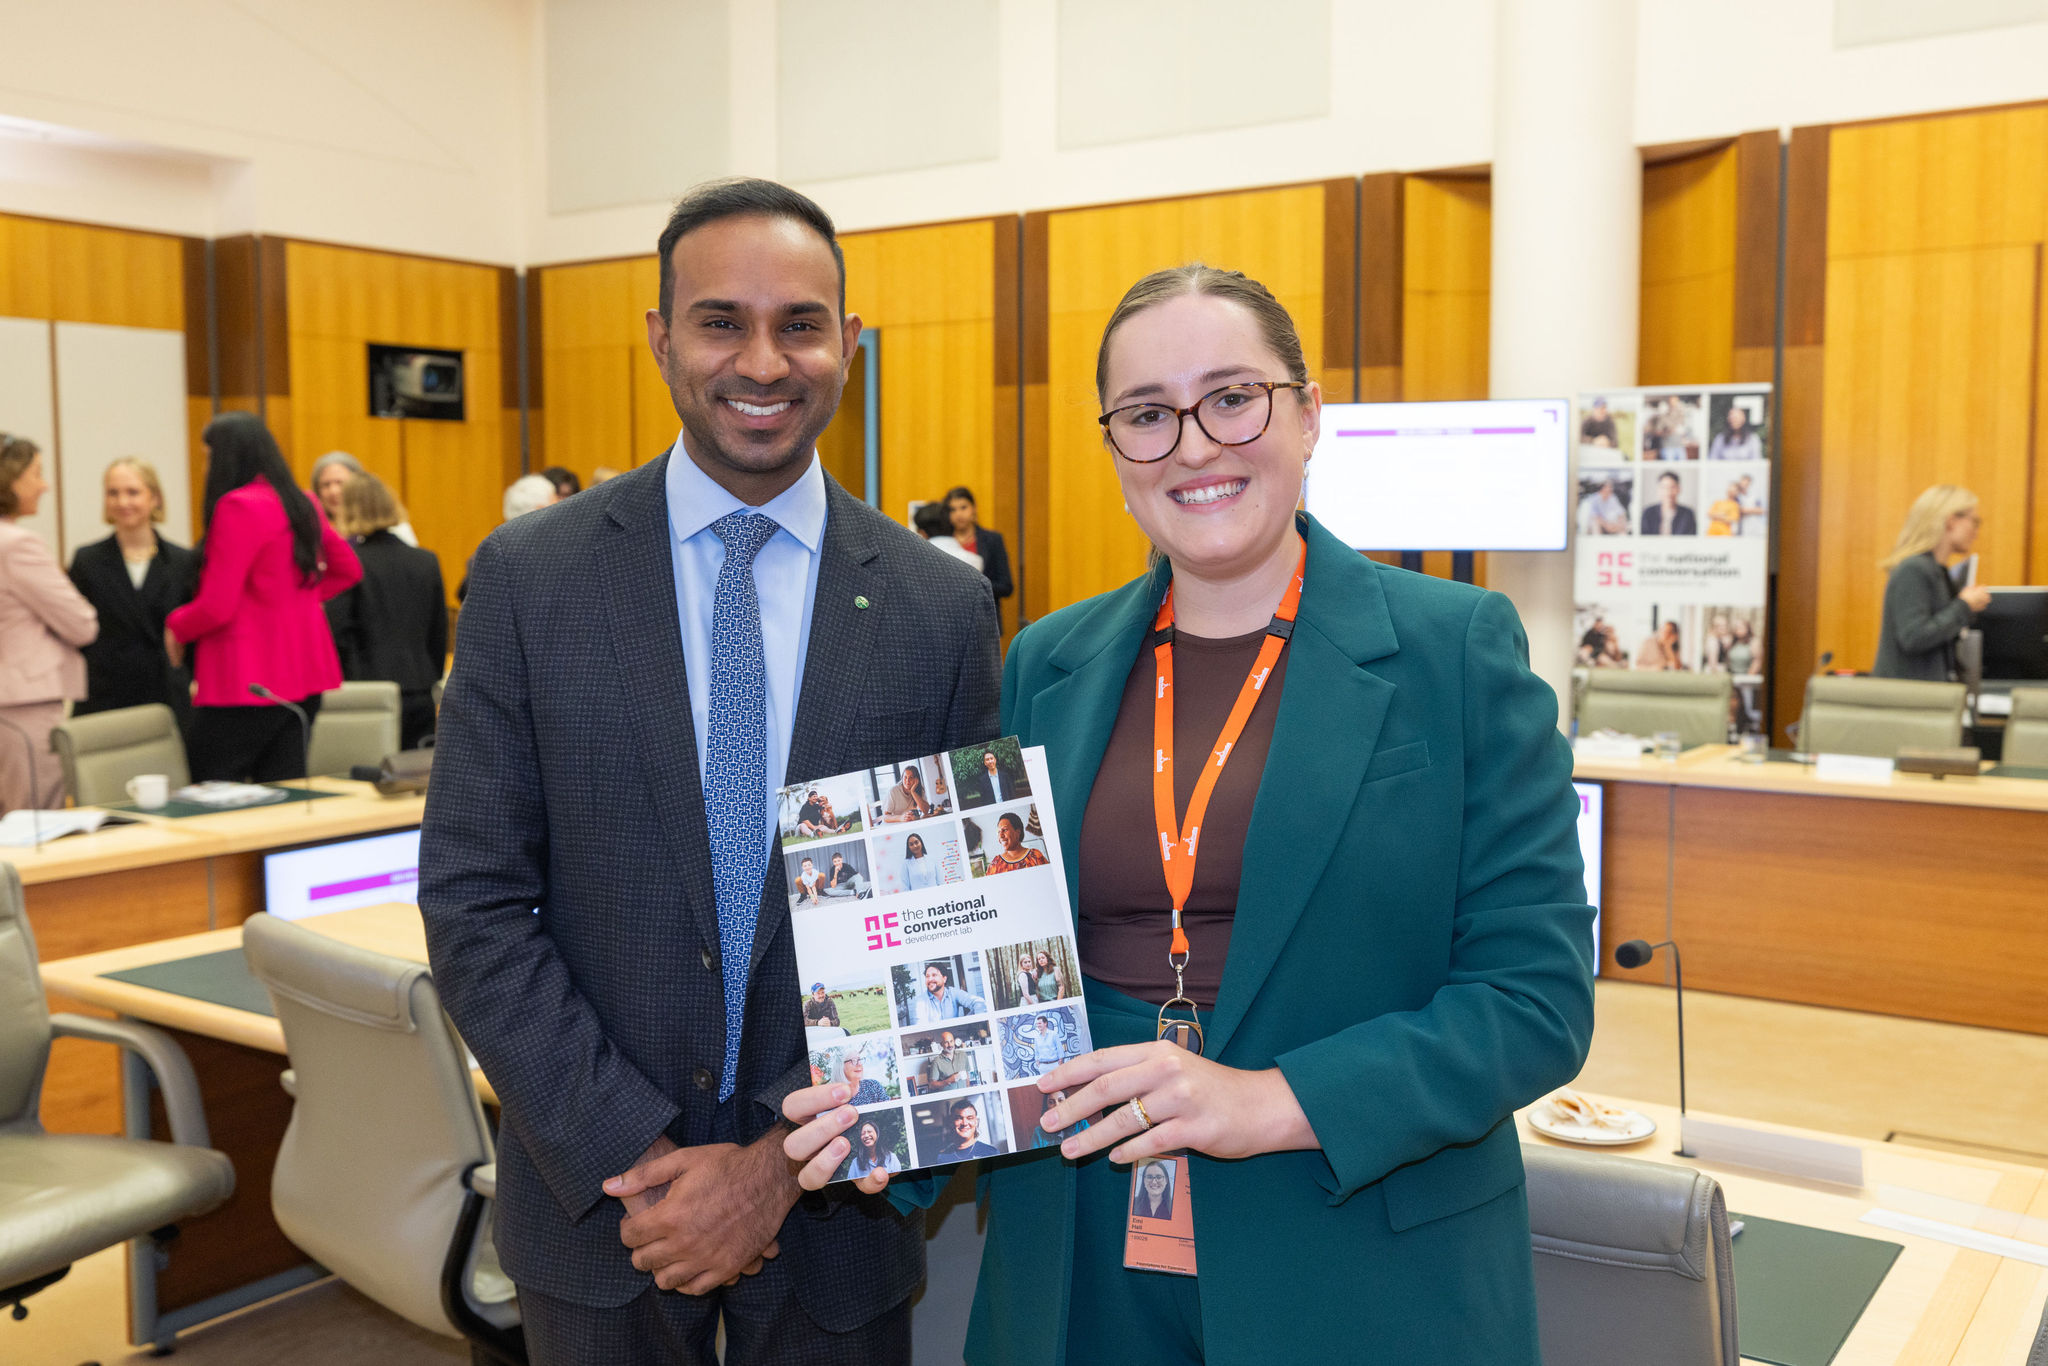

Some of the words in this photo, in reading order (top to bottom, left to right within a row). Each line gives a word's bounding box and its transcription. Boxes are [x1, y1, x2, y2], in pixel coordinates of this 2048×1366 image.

[901, 909, 924, 922] the
[927, 894, 986, 918] national
[903, 908, 998, 935] conversation
[905, 928, 958, 945] development
[959, 925, 973, 936] lab
